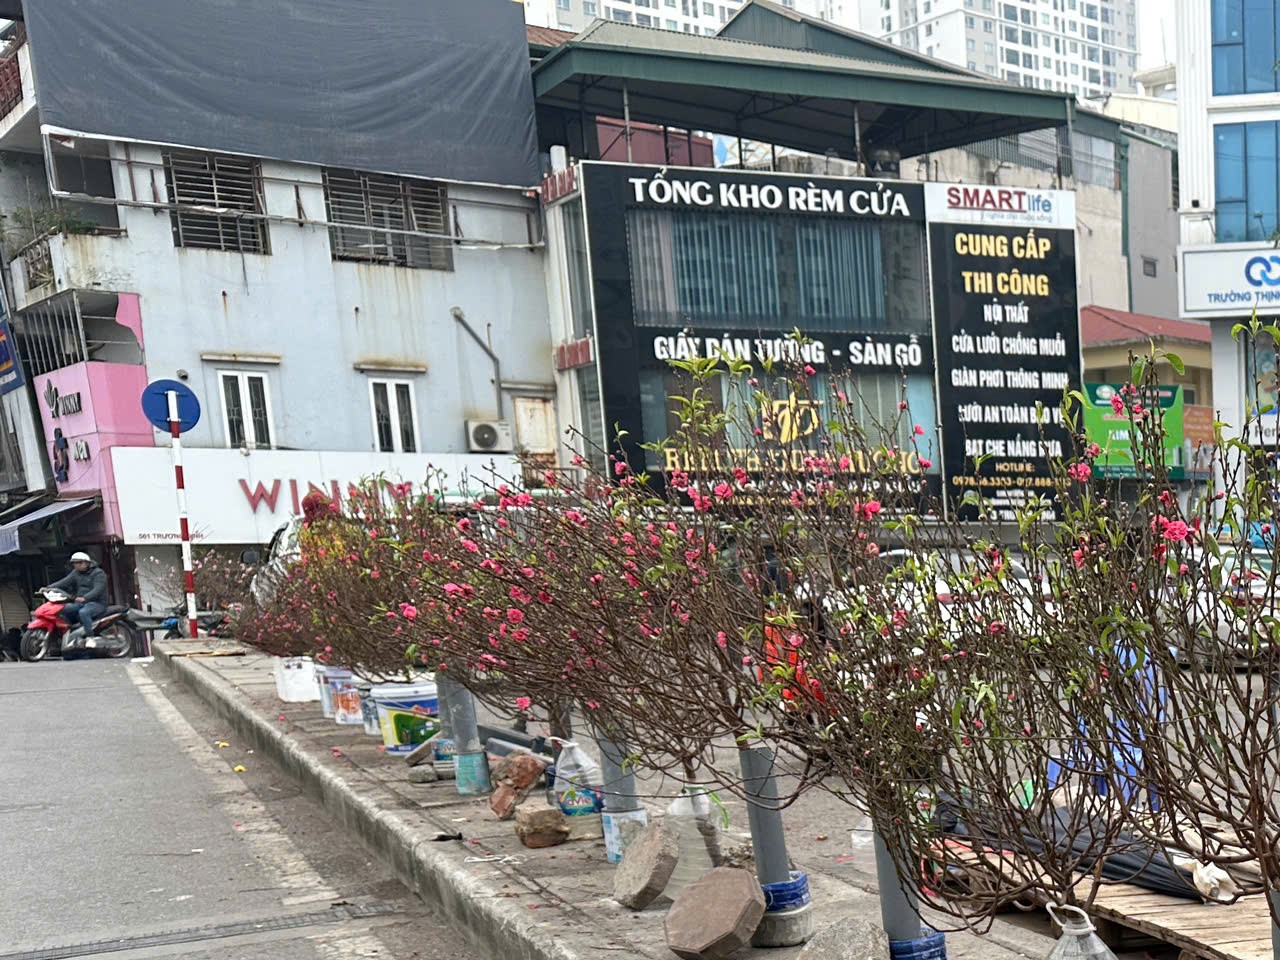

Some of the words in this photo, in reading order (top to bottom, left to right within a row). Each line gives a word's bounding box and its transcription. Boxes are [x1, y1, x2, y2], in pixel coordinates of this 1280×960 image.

[628, 166, 713, 206] TỔNG
[719, 183, 777, 209] KHO
[788, 182, 845, 213] RÈM
[849, 182, 911, 217] CỬA
[954, 232, 1009, 258] CUNG
[1012, 228, 1052, 259] CẤP
[961, 271, 994, 293] THI
[996, 268, 1049, 296] CÔNG
[1207, 290, 1252, 303] TRƯỜNG
[983, 297, 1003, 325] NỘI
[1004, 300, 1030, 323] THẤT
[653, 328, 701, 360] GIẤY
[704, 333, 751, 361] DÁN
[849, 336, 891, 365] SÀN
[894, 334, 922, 366] GỖ
[951, 328, 975, 353] CỬA
[976, 330, 1000, 354] LƯỚI
[1002, 331, 1038, 355] CHỐNG
[951, 366, 977, 387] GIÀN
[979, 368, 1004, 388] PHƠI
[1005, 367, 1039, 389] THÔNG
[1041, 371, 1069, 389] MINH
[984, 405, 1000, 423] AN
[1000, 403, 1028, 424] TOÀN
[1029, 405, 1051, 424] BO
[1006, 433, 1037, 457] NẮNG
